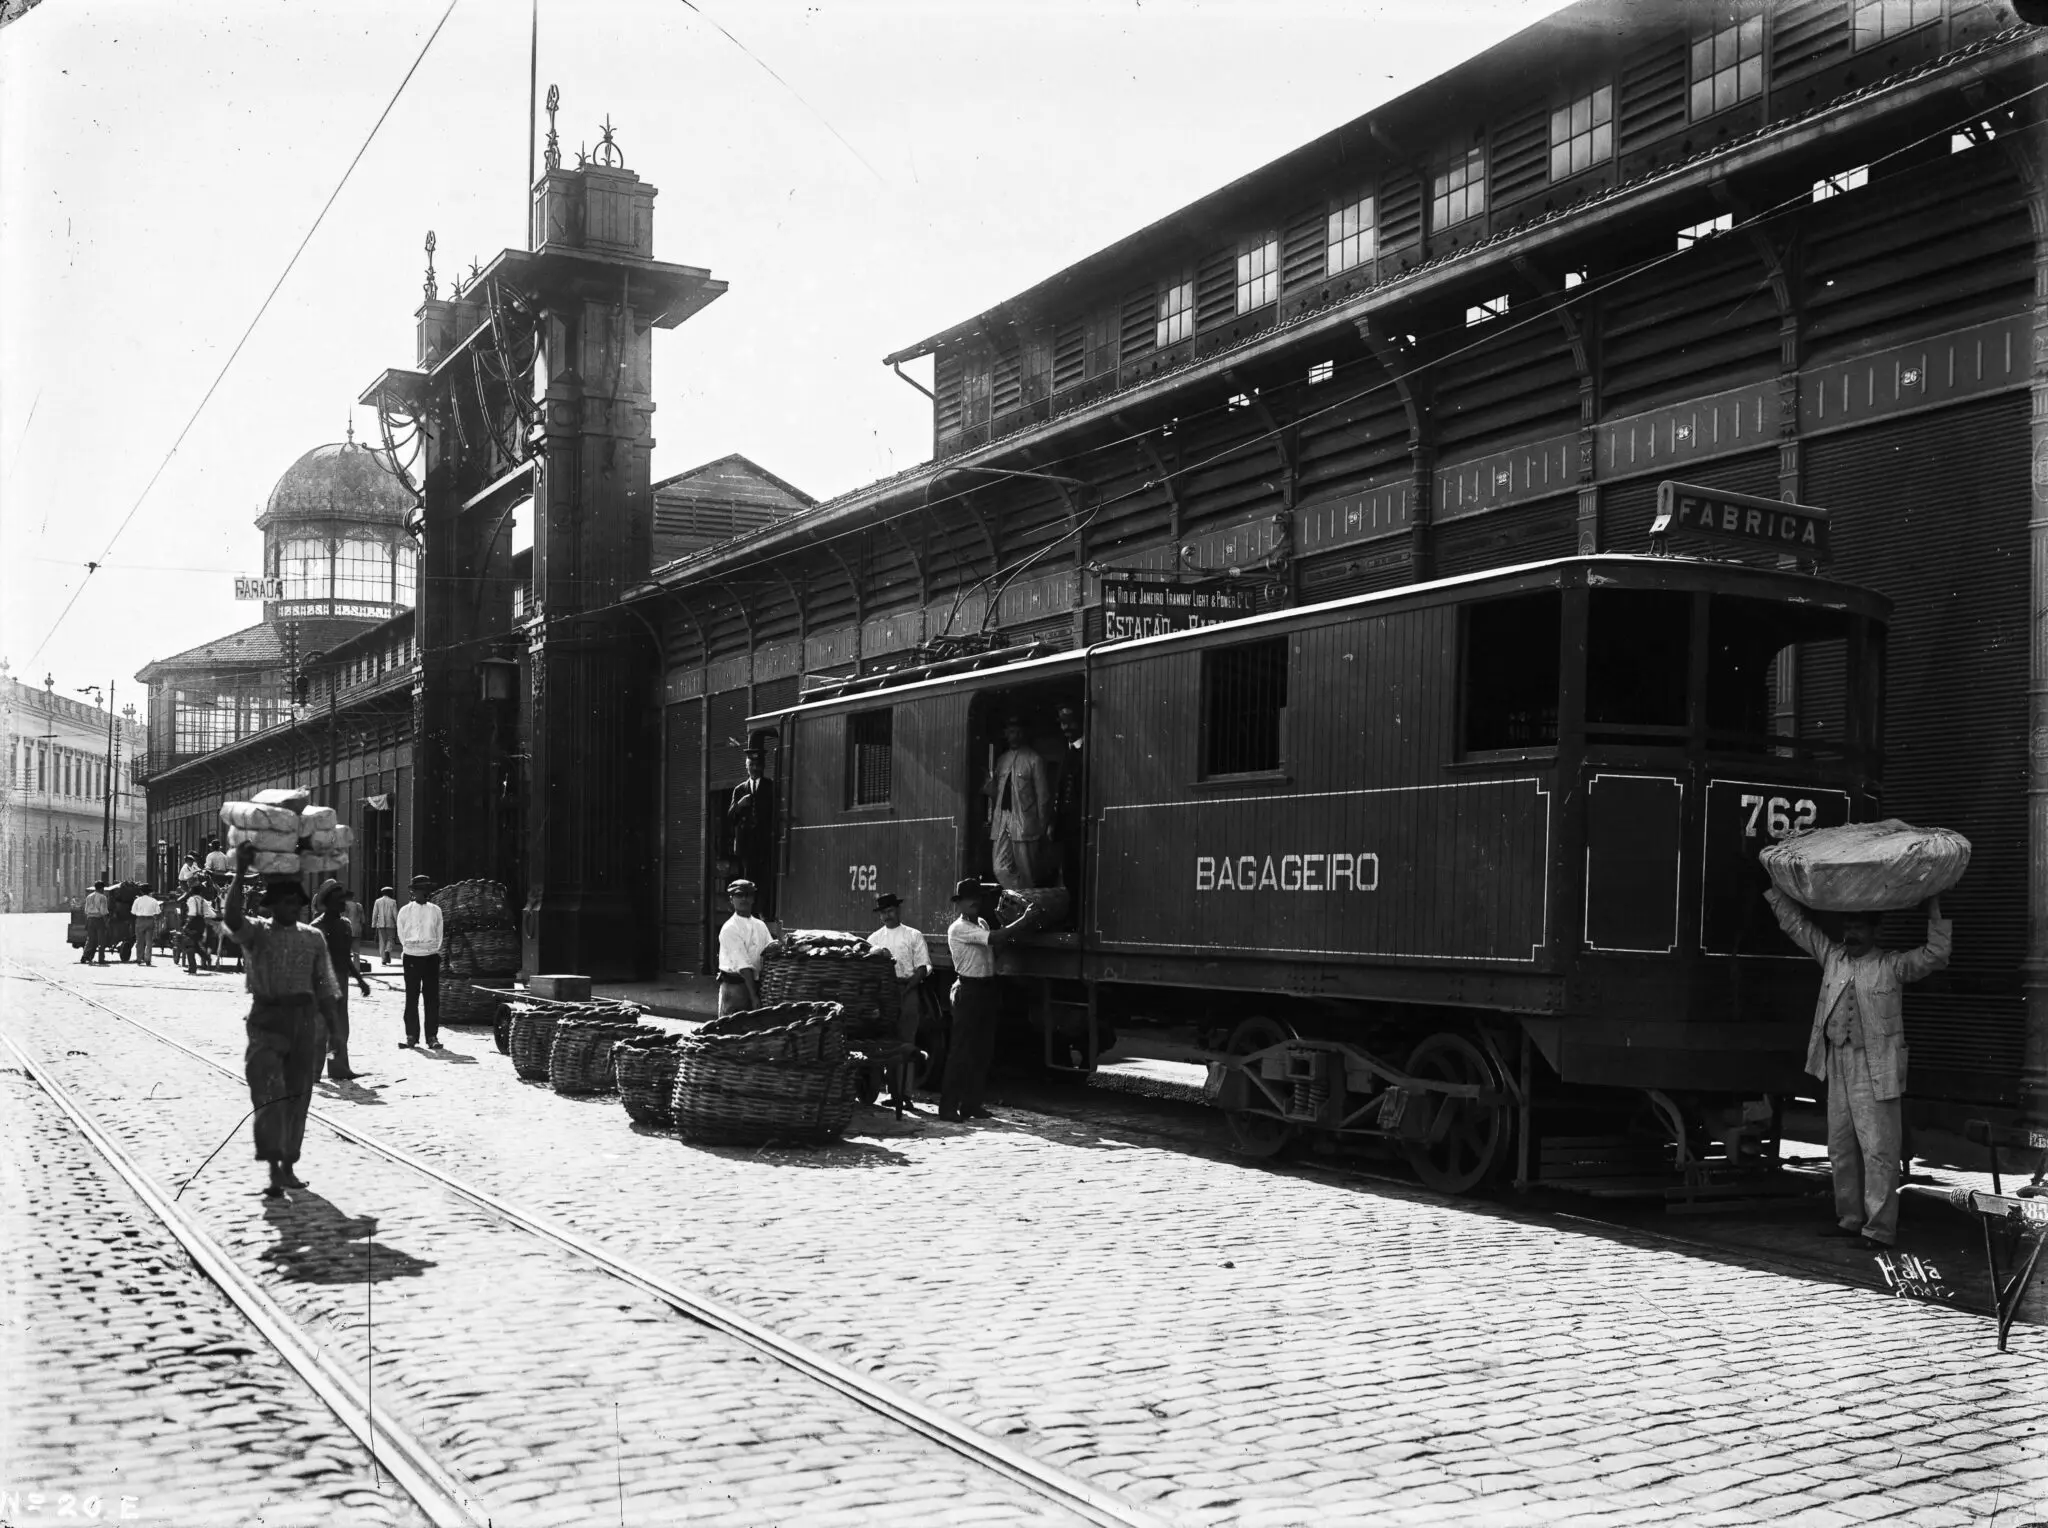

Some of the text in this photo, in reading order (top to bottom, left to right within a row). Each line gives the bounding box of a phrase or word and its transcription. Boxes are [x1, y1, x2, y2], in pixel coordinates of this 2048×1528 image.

[1903, 370, 1917, 383] 26
[1678, 497, 1816, 545] FABRICA
[235, 579, 283, 599] PARADA
[1139, 587, 1164, 606] JANEIRO
[1165, 588, 1192, 606] TRAMWAY
[1193, 589, 1209, 607] LIGHT
[1740, 794, 1817, 839] 762
[849, 864, 877, 891] 762
[1196, 853, 1379, 891] BAGAGEIRO
